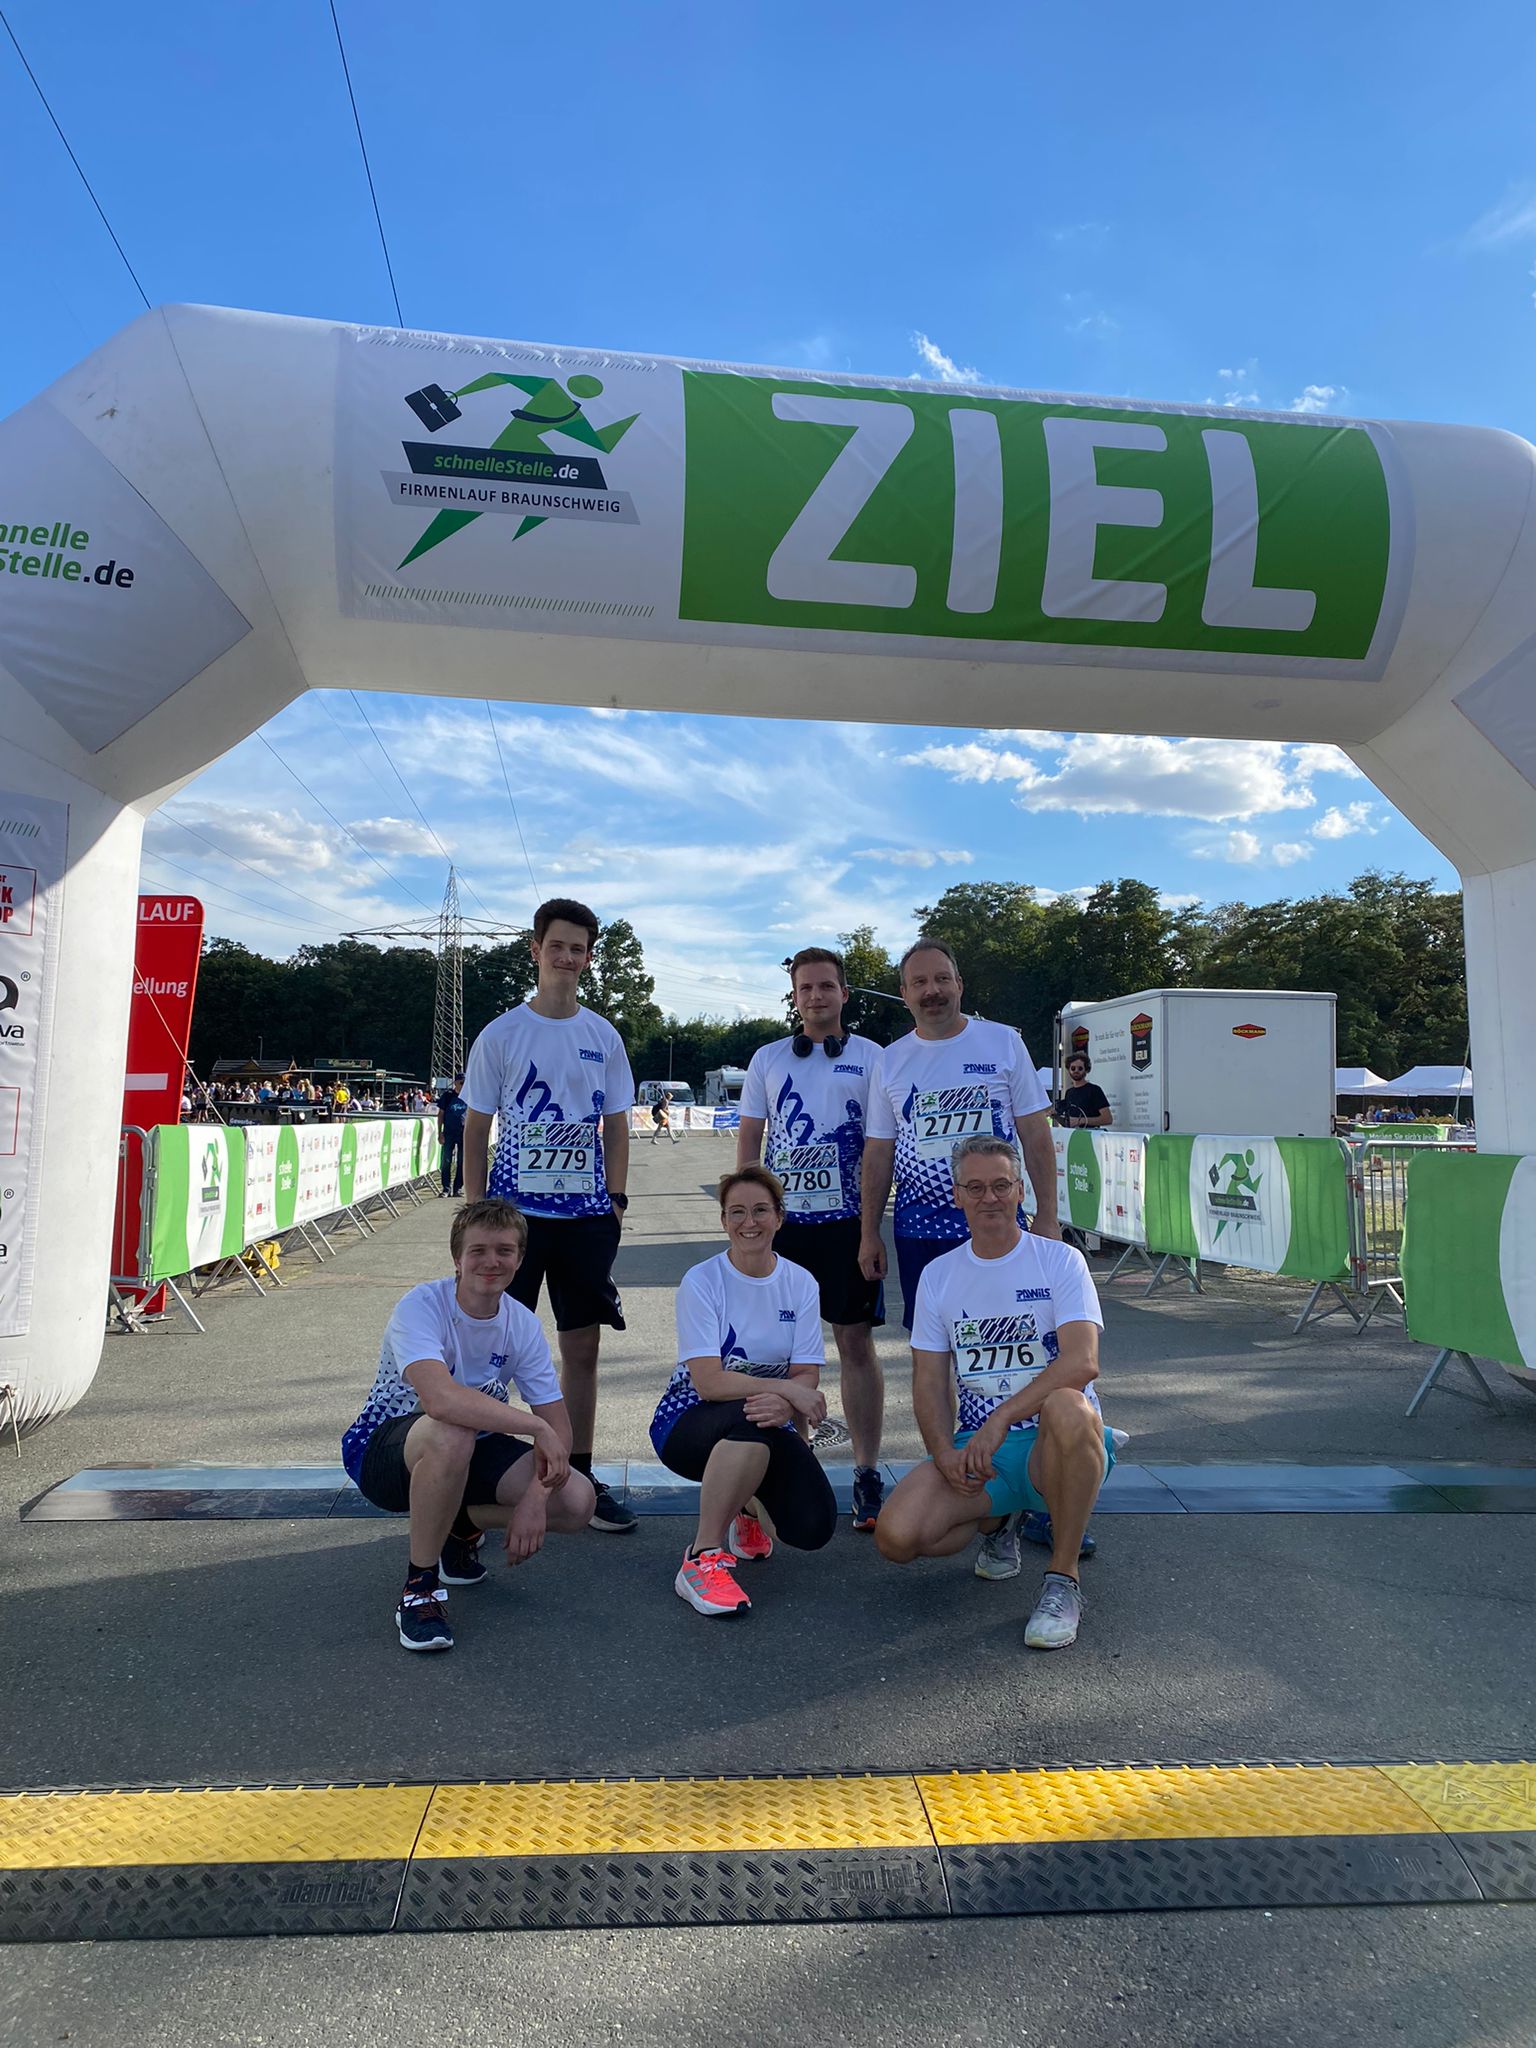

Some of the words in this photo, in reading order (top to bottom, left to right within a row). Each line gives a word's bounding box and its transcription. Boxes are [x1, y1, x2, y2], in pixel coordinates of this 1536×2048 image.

[433, 454, 579, 479] schnelleStelle.de
[400, 482, 497, 502] FIRMENLAUF
[501, 491, 621, 513] BRAUNSCHWEIG
[766, 392, 1316, 631] ZIEL
[139, 902, 195, 921] LAUF
[133, 977, 188, 997] ellung
[924, 1110, 983, 1137] 2777
[527, 1148, 587, 1171] 2779
[779, 1169, 831, 1192] 2780
[966, 1343, 1035, 1372] 2776
